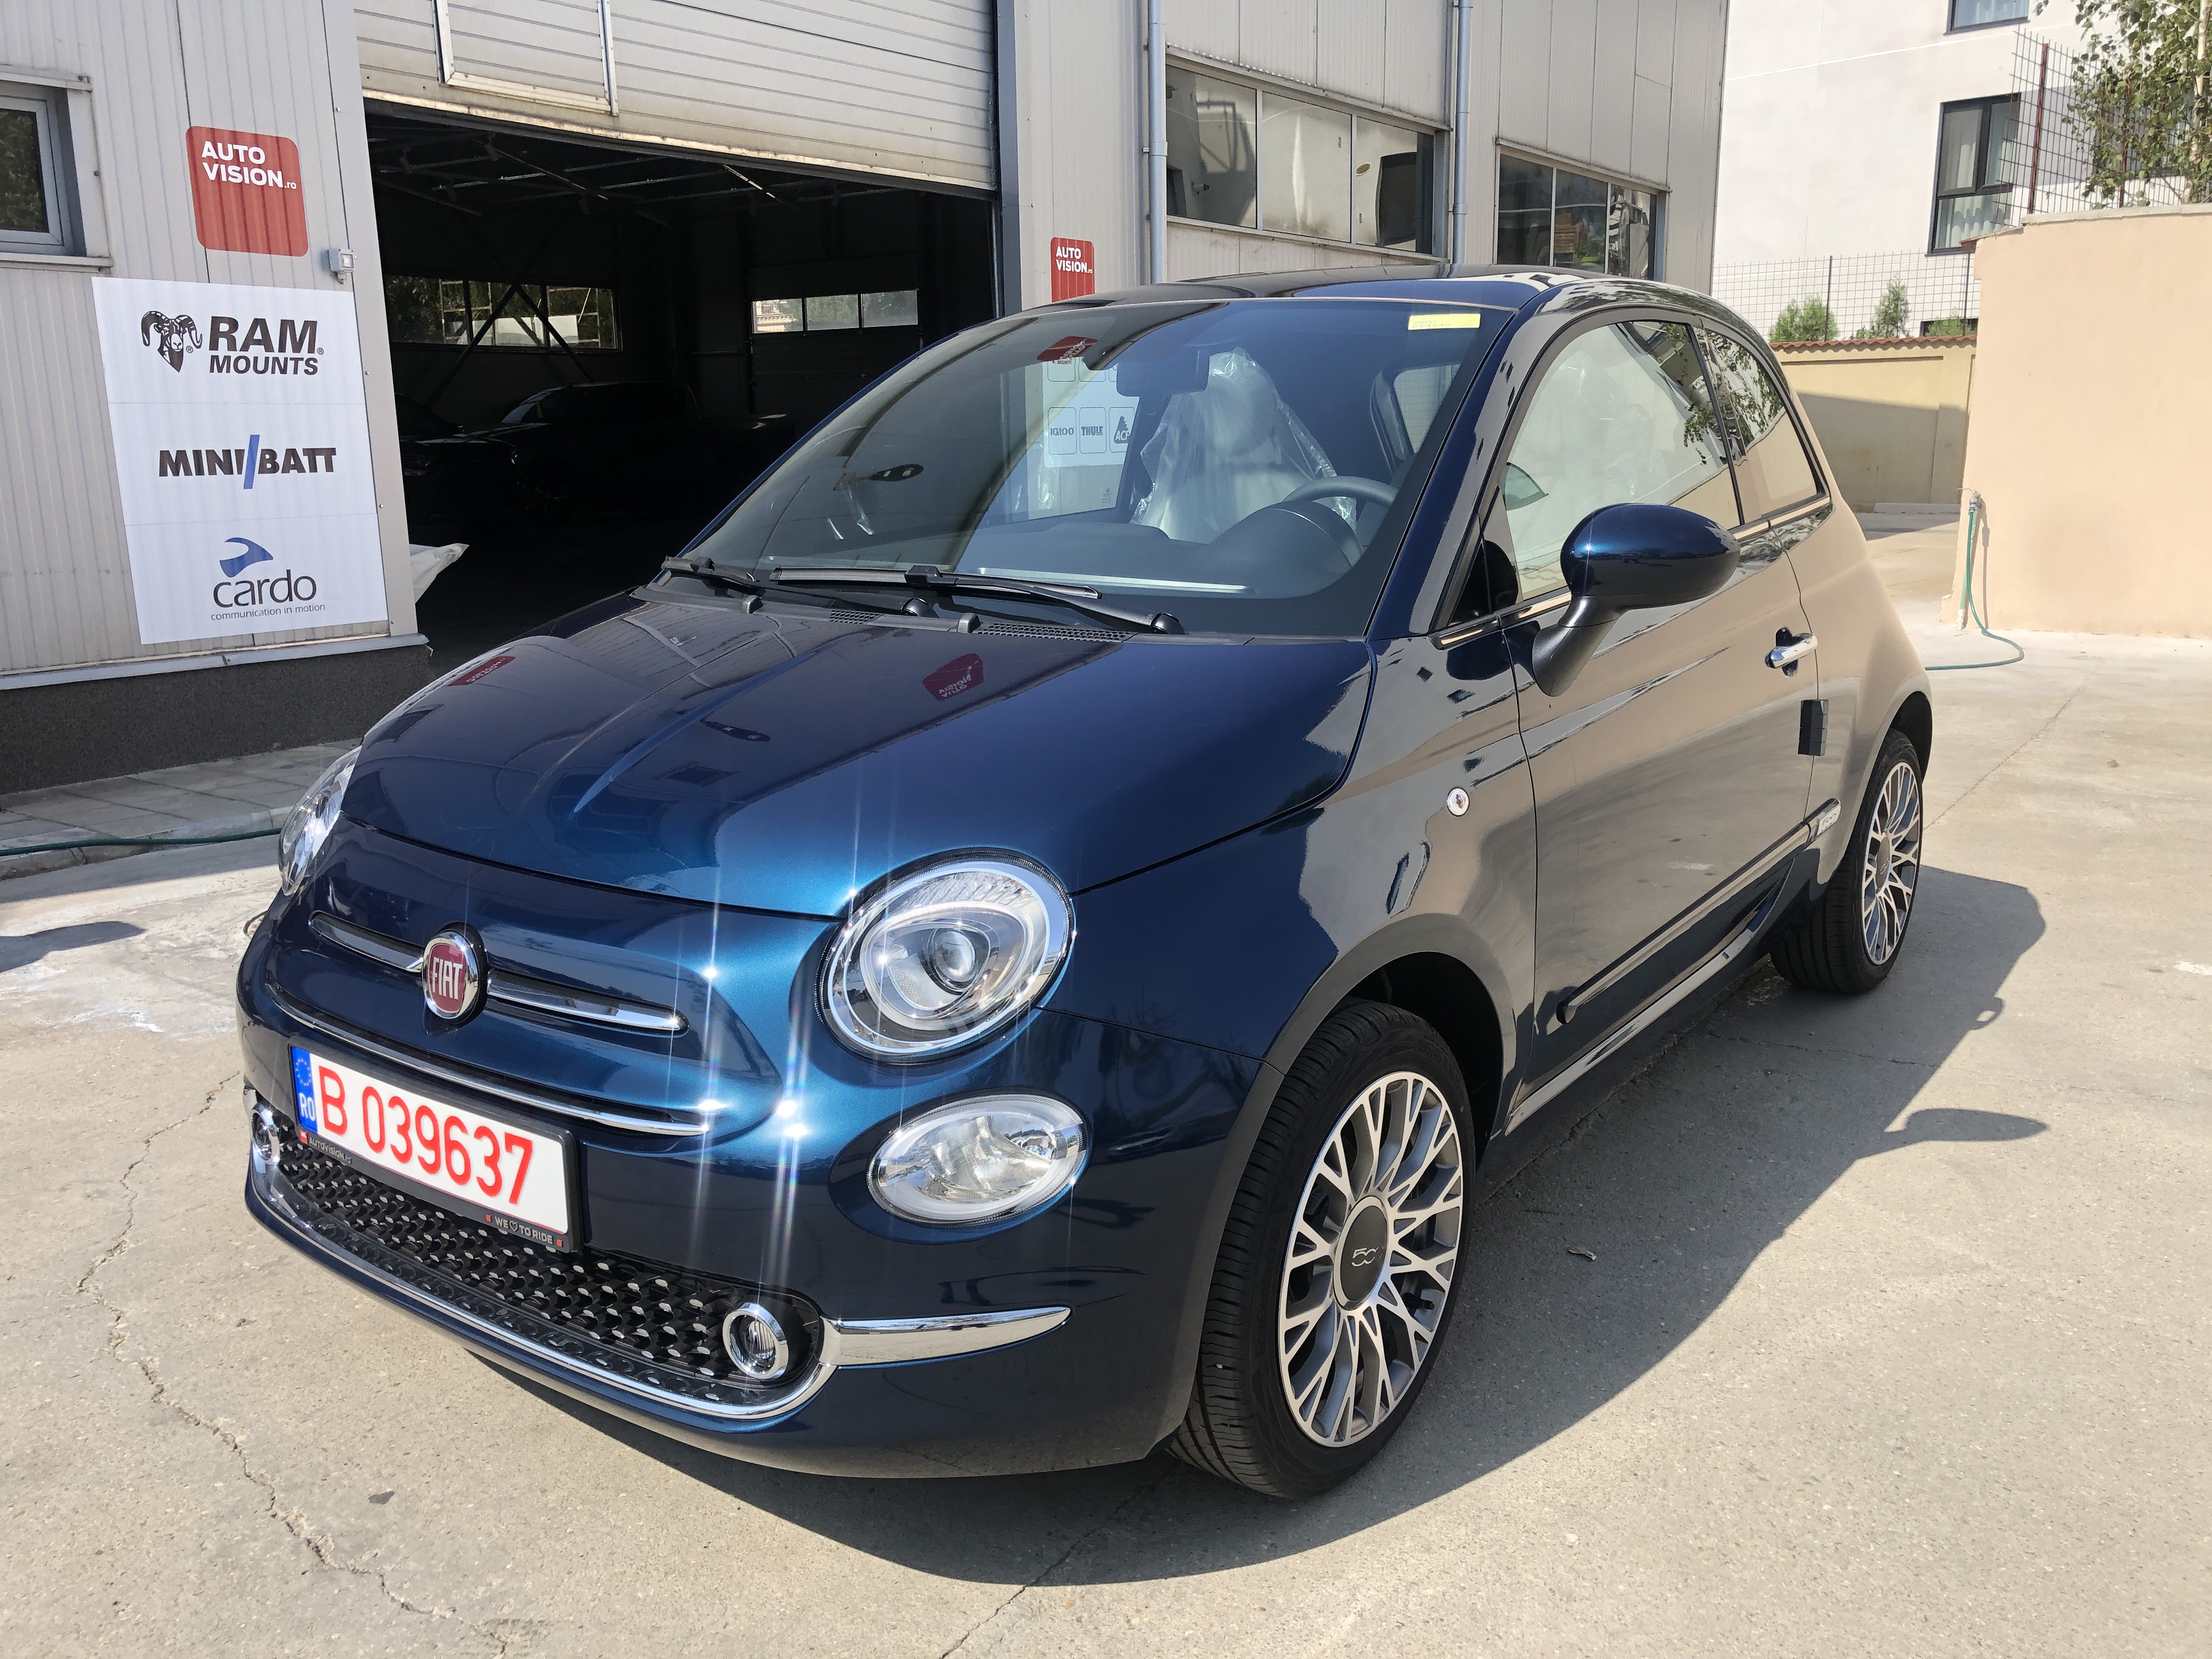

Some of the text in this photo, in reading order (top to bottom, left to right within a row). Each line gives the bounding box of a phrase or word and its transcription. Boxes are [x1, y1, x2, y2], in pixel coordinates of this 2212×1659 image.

[201, 141, 266, 165] AUTO
[1056, 246, 1081, 259] AUTO
[208, 315, 318, 354] RAM
[209, 355, 318, 376] MOUNTS
[1050, 427, 1074, 436] IGLOO
[1081, 426, 1103, 436] THULE
[213, 569, 317, 608] cardo
[211, 607, 281, 620] communication
[295, 605, 325, 613] motion
[432, 957, 463, 1000] FIAT
[300, 1091, 316, 1121] RO
[318, 1065, 533, 1204] B 039637
[494, 1216, 554, 1245] WE TO RIDE
